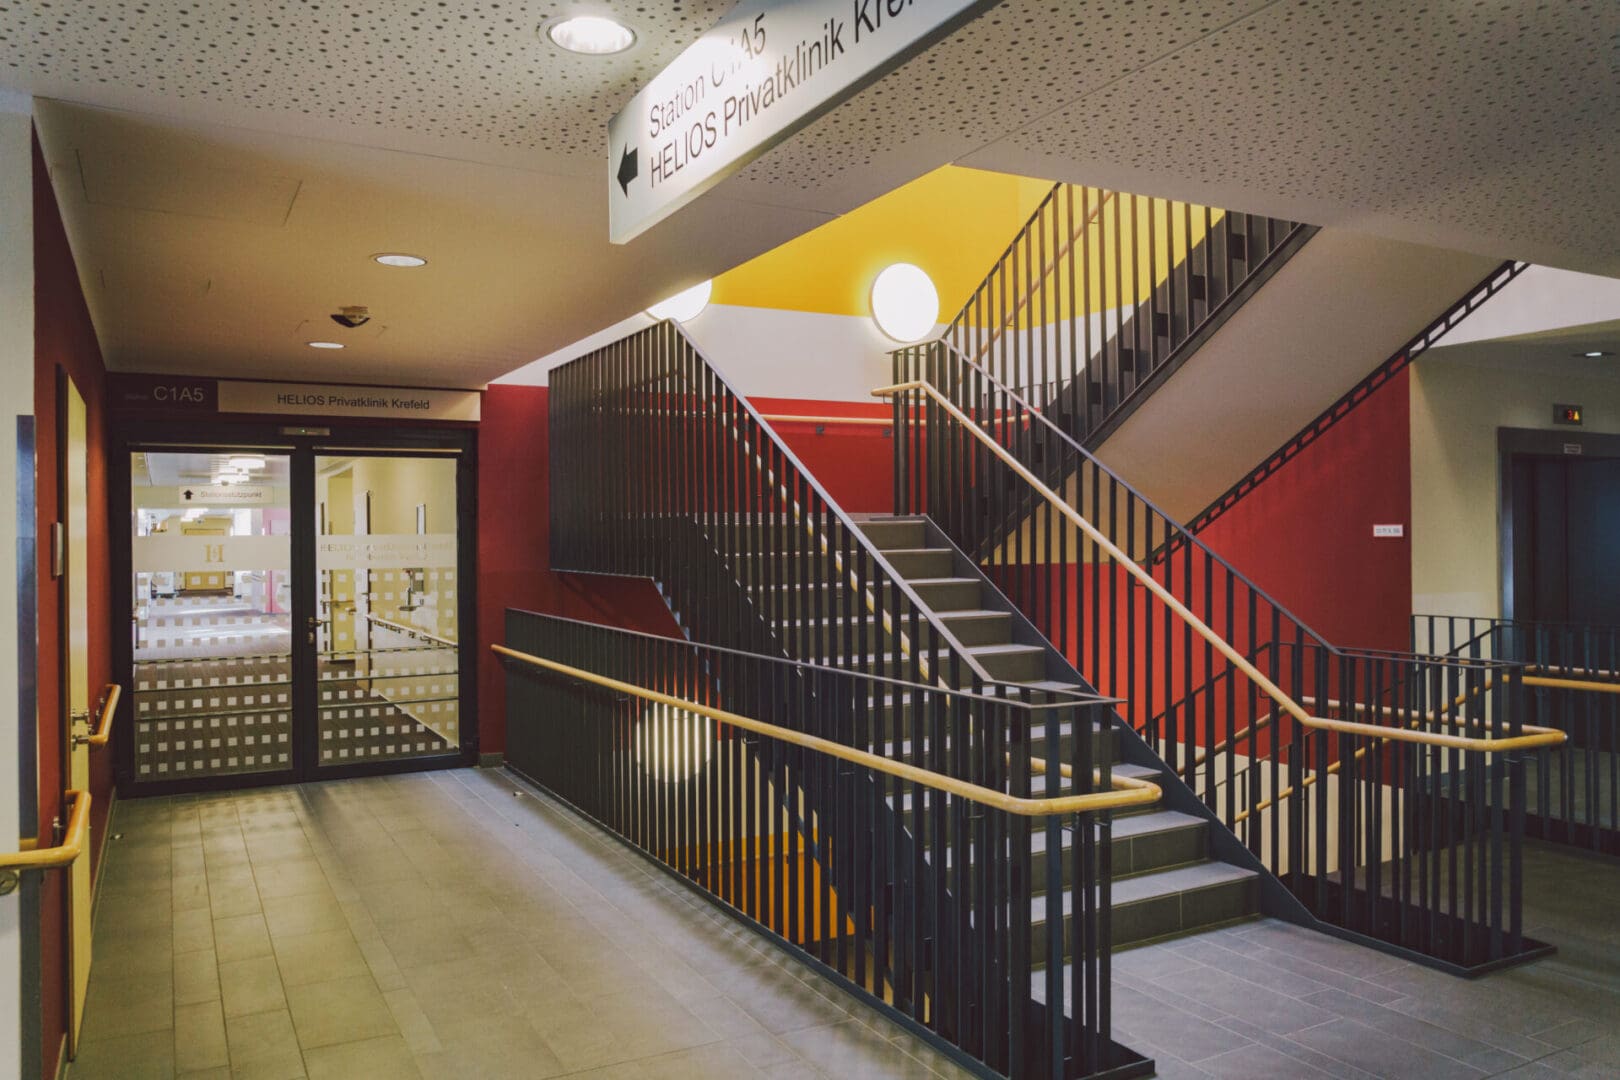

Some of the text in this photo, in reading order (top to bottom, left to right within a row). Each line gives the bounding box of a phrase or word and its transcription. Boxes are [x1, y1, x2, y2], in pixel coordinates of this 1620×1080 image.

[650, 0, 914, 188] HELIOS Privatklinik Kre
[650, 74, 705, 139] Station
[153, 385, 204, 402] C1A5
[277, 394, 431, 410] HELIOS Privatklinik Krefeld
